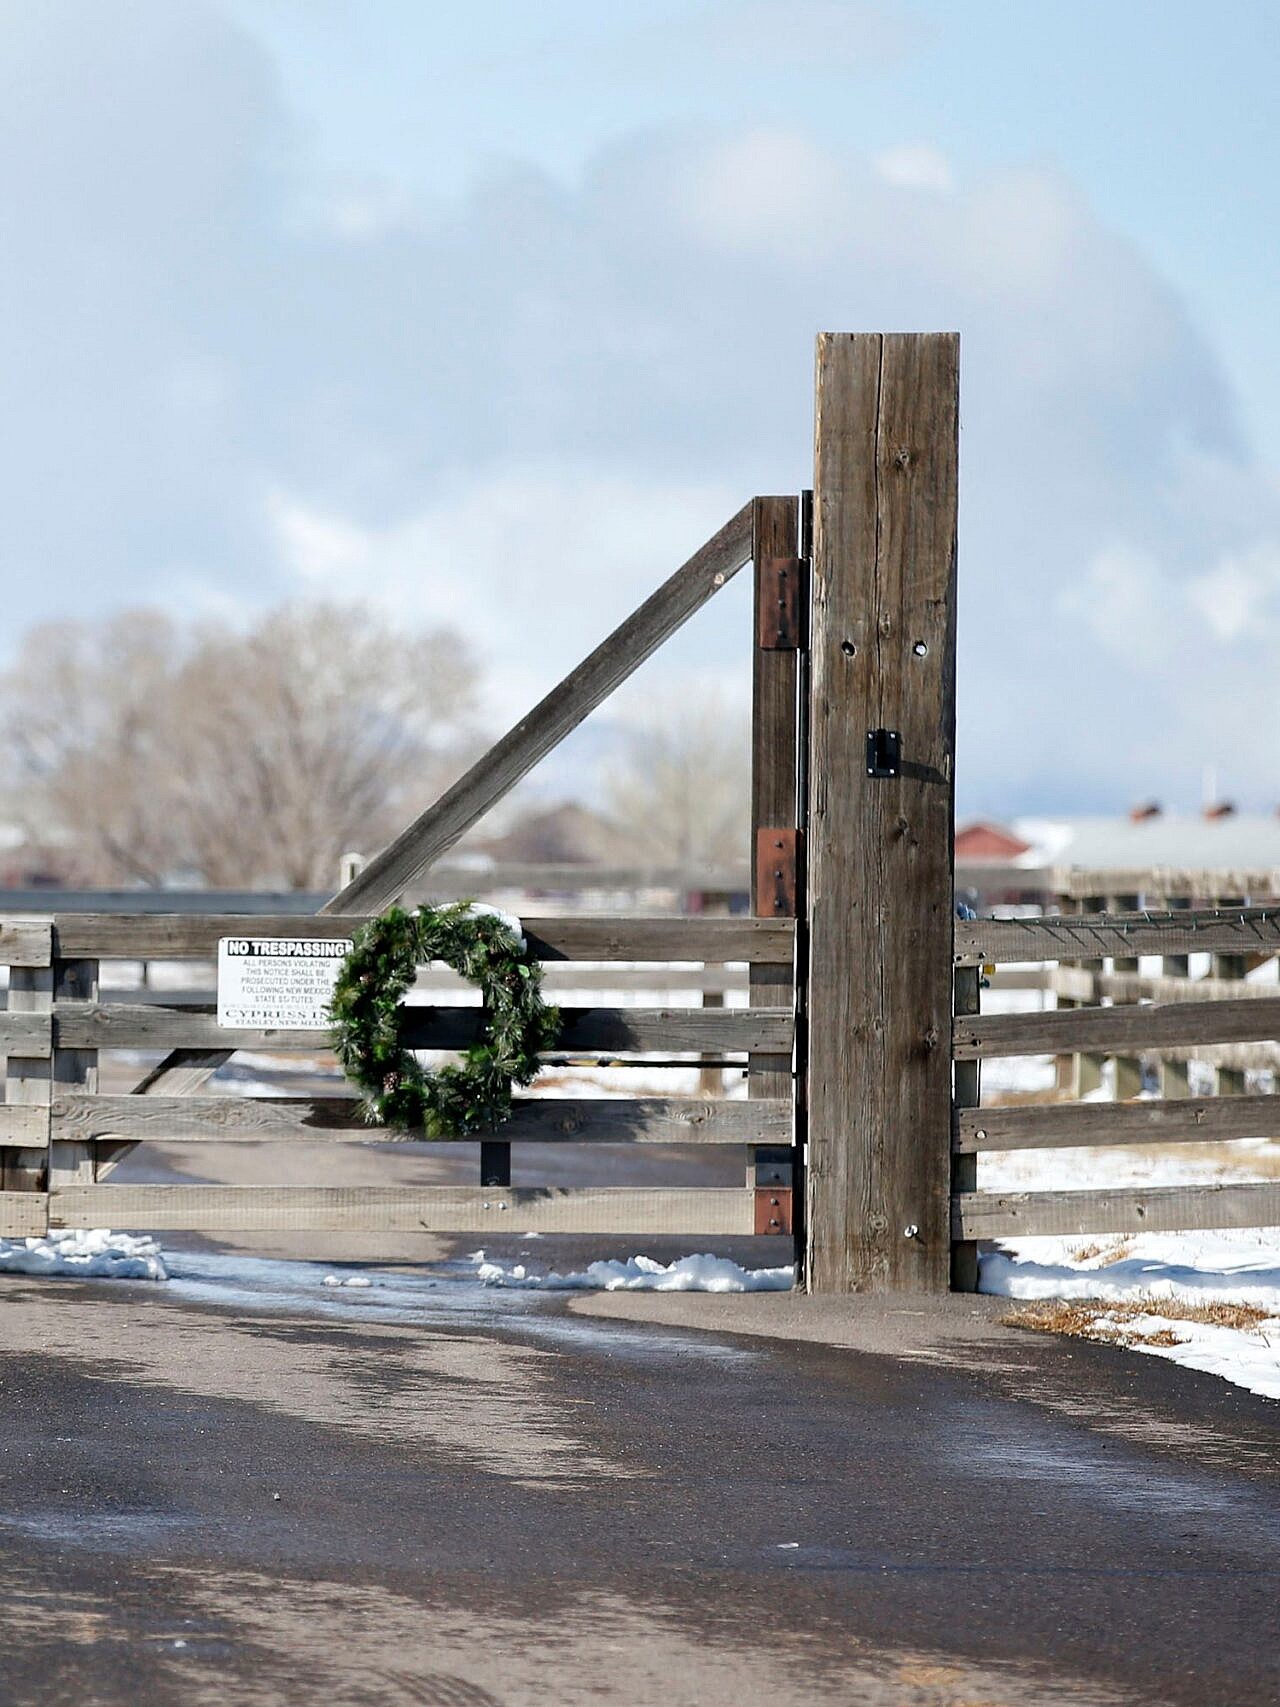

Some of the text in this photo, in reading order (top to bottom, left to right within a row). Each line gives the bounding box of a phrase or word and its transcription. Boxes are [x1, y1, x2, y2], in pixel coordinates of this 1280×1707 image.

[229, 942, 344, 956] NO TRESPASSING
[226, 1010, 305, 1018] CYPRESS
